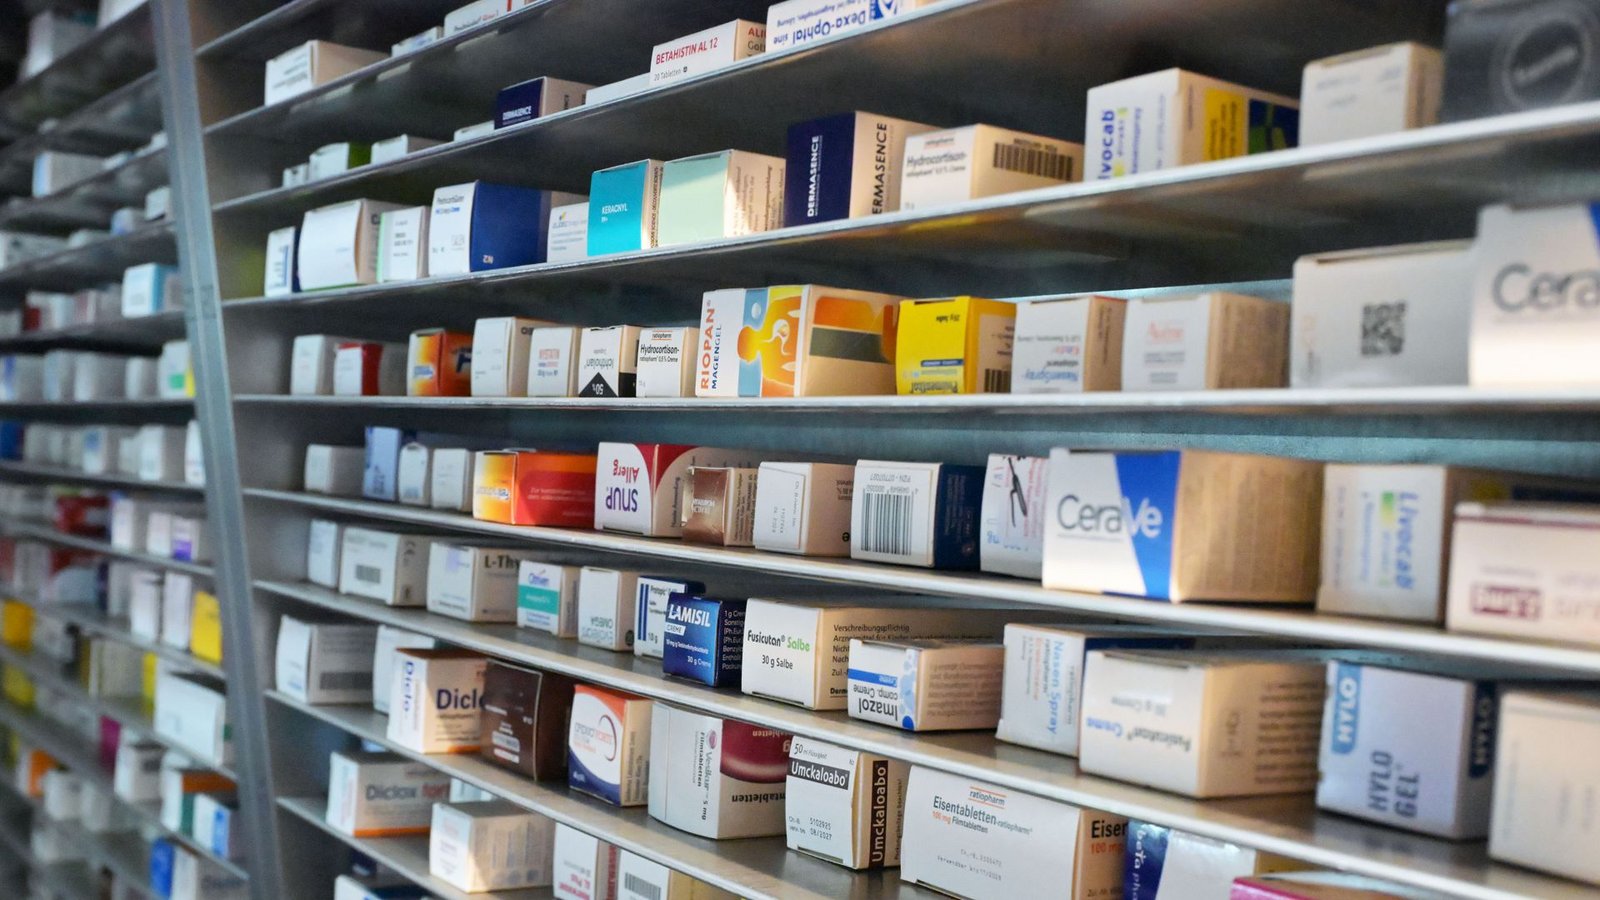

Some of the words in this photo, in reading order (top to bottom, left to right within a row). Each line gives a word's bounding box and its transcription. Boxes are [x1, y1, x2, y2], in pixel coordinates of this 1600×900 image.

[656, 43, 697, 65] BETAHISTIN
[698, 40, 708, 52] AL
[709, 37, 718, 49] 12
[807, 136, 819, 217] DERMASENCE
[640, 344, 680, 355] Hydrocortison-
[711, 326, 722, 390] MAGENGEL
[613, 459, 640, 484] Allerg
[1057, 495, 1163, 538] CeraVe
[668, 604, 711, 628] LAMISIL
[666, 624, 683, 633] CREME
[833, 624, 910, 634] Verschreibungspflichtig
[786, 638, 811, 652] Salbe
[761, 654, 770, 665] 30
[770, 658, 775, 668] g
[776, 657, 793, 670] Salbe
[853, 684, 875, 698] Creme
[858, 698, 898, 722] Imazol
[1338, 677, 1358, 744] HYLO
[794, 743, 803, 755] 50
[1368, 750, 1393, 812] HYLO
[969, 790, 1005, 806] ratiopharm
[1394, 773, 1420, 819] GEL
[872, 766, 887, 862] Umckaloabo
[952, 816, 988, 833] Filmtabletten
